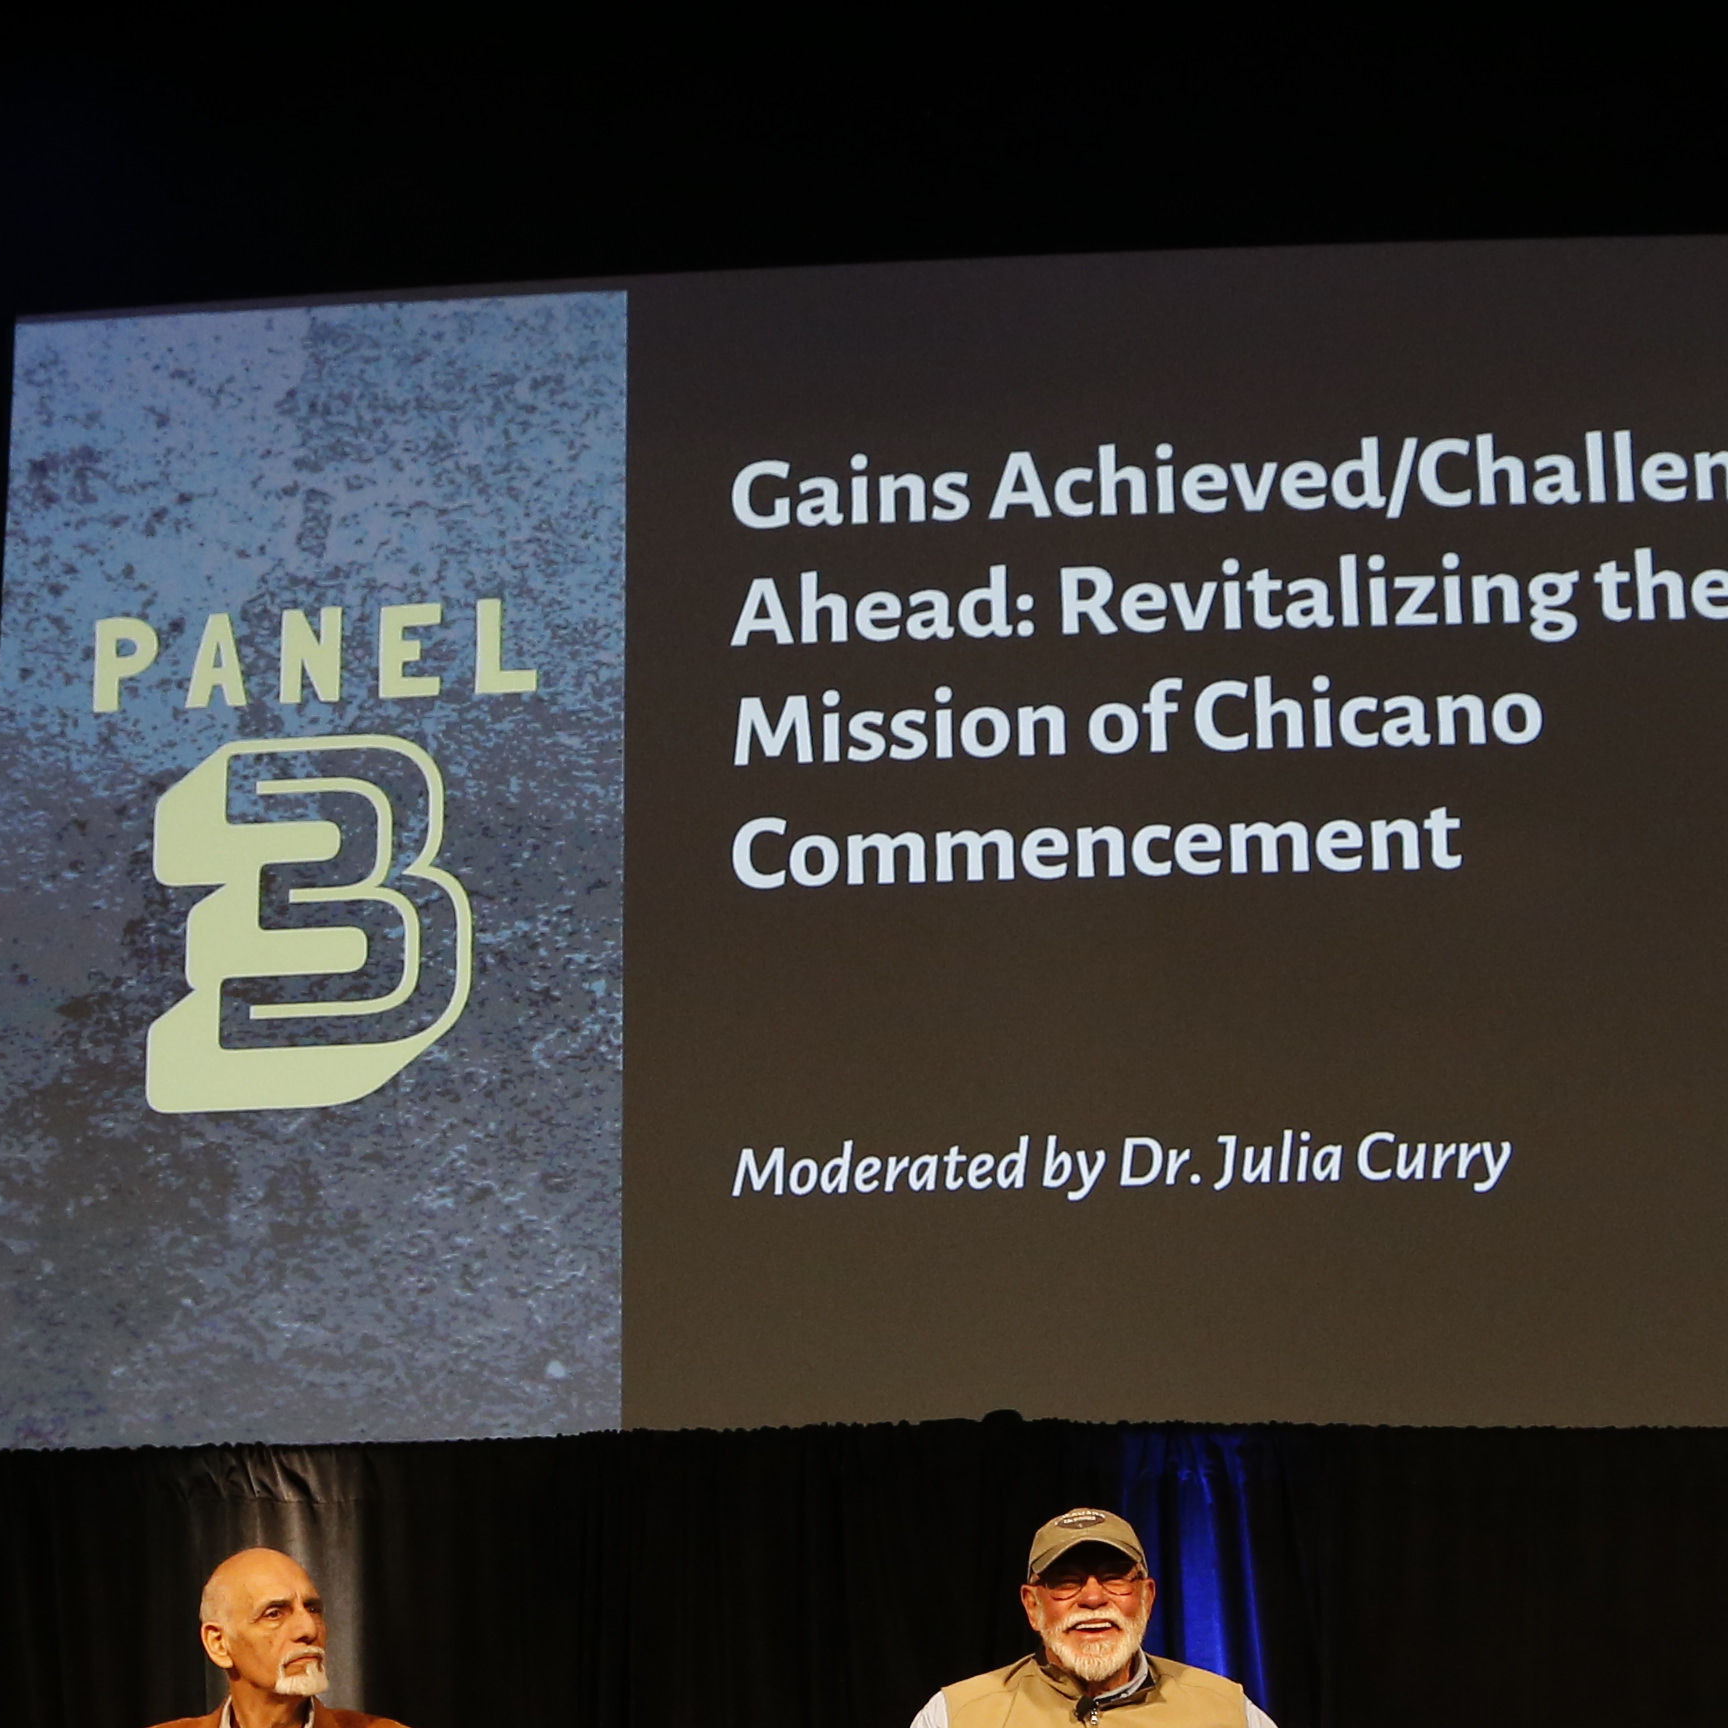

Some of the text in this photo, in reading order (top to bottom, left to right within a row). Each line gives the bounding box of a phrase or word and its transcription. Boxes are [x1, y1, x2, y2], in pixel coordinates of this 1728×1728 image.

[731, 453, 972, 529] Gains
[730, 564, 1035, 647] Ahead:
[1060, 552, 1581, 642] Revitalizing
[93, 599, 538, 713] PANEL
[733, 674, 1543, 766] Mission of Chicano
[732, 806, 1462, 889] Commencement
[147, 734, 473, 1113] 3
[731, 1129, 1512, 1201] Moderated by Dr. Julia Curry
